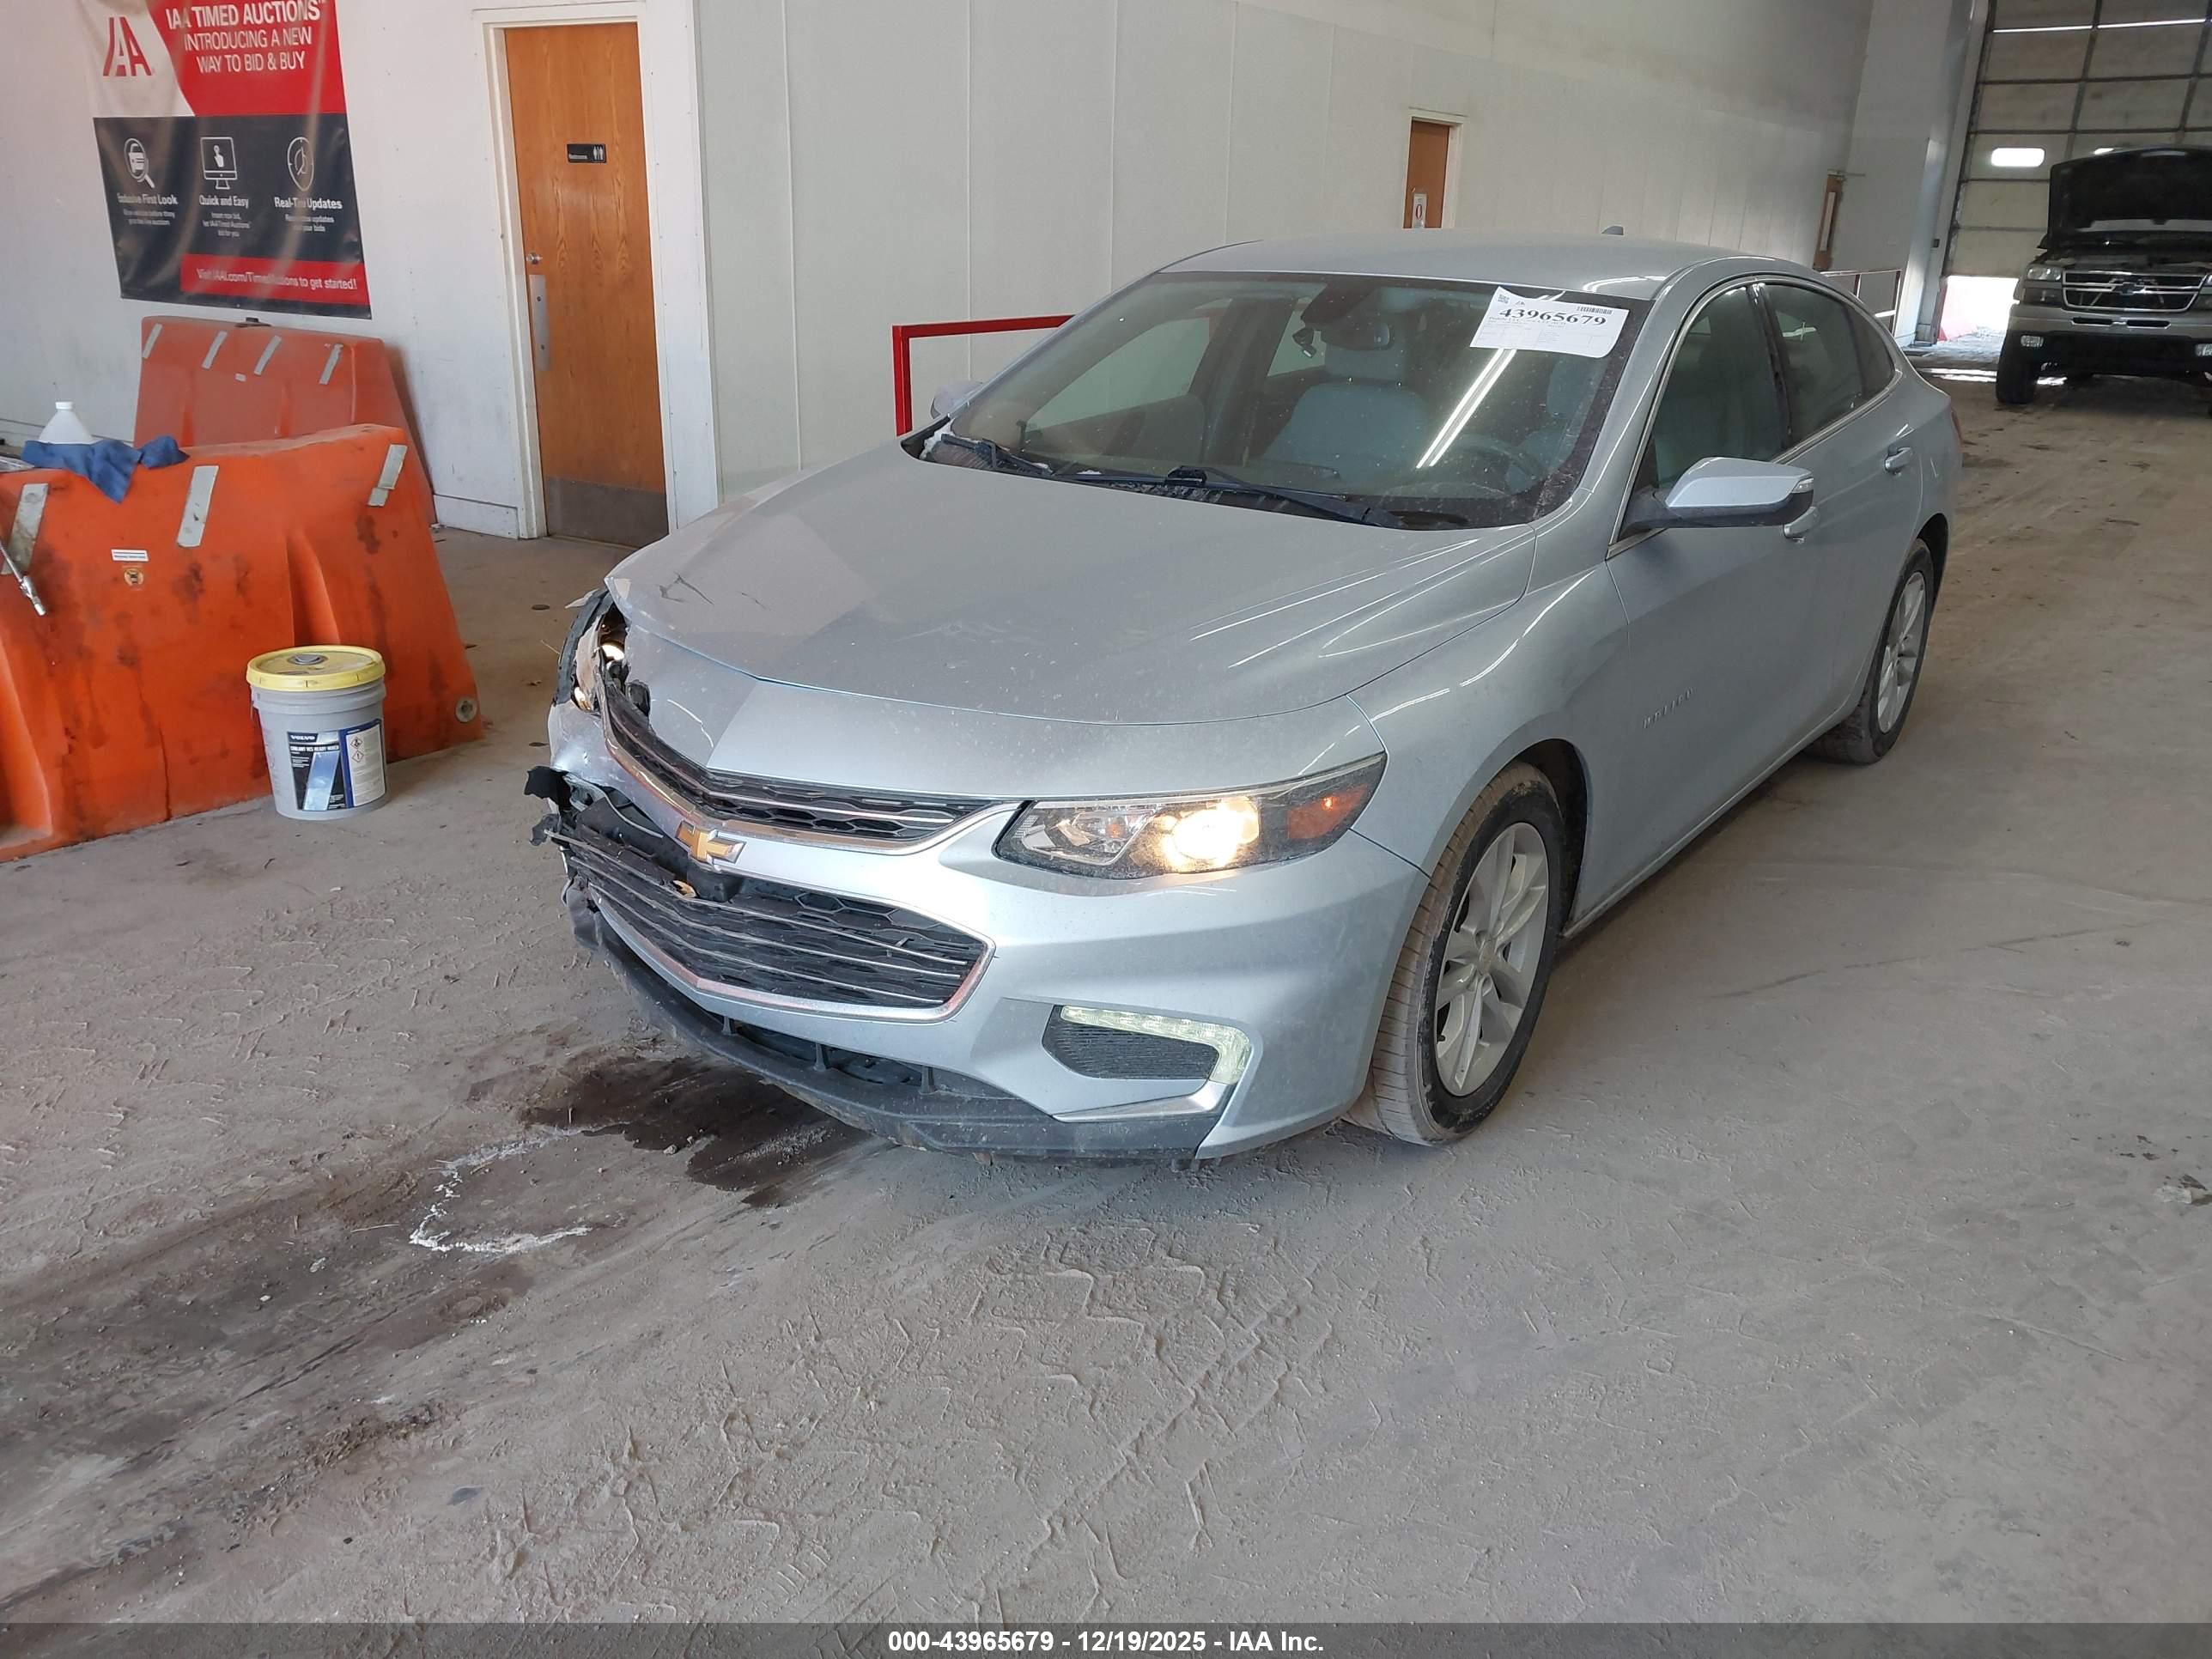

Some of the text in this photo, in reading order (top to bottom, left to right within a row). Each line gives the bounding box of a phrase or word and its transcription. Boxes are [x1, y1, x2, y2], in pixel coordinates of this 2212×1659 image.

[166, 8, 191, 30] IAA
[191, 4, 240, 28] TIMED
[185, 27, 313, 52] INTRODUCING A NEW
[196, 51, 306, 74] WAY TO BID & BUY
[157, 194, 179, 206] Look
[199, 194, 249, 210] Quick and Easy
[307, 198, 343, 211] Updates
[299, 277, 309, 289] to
[310, 278, 323, 291] get
[324, 278, 358, 290] started!
[1498, 307, 1607, 326] 43965679
